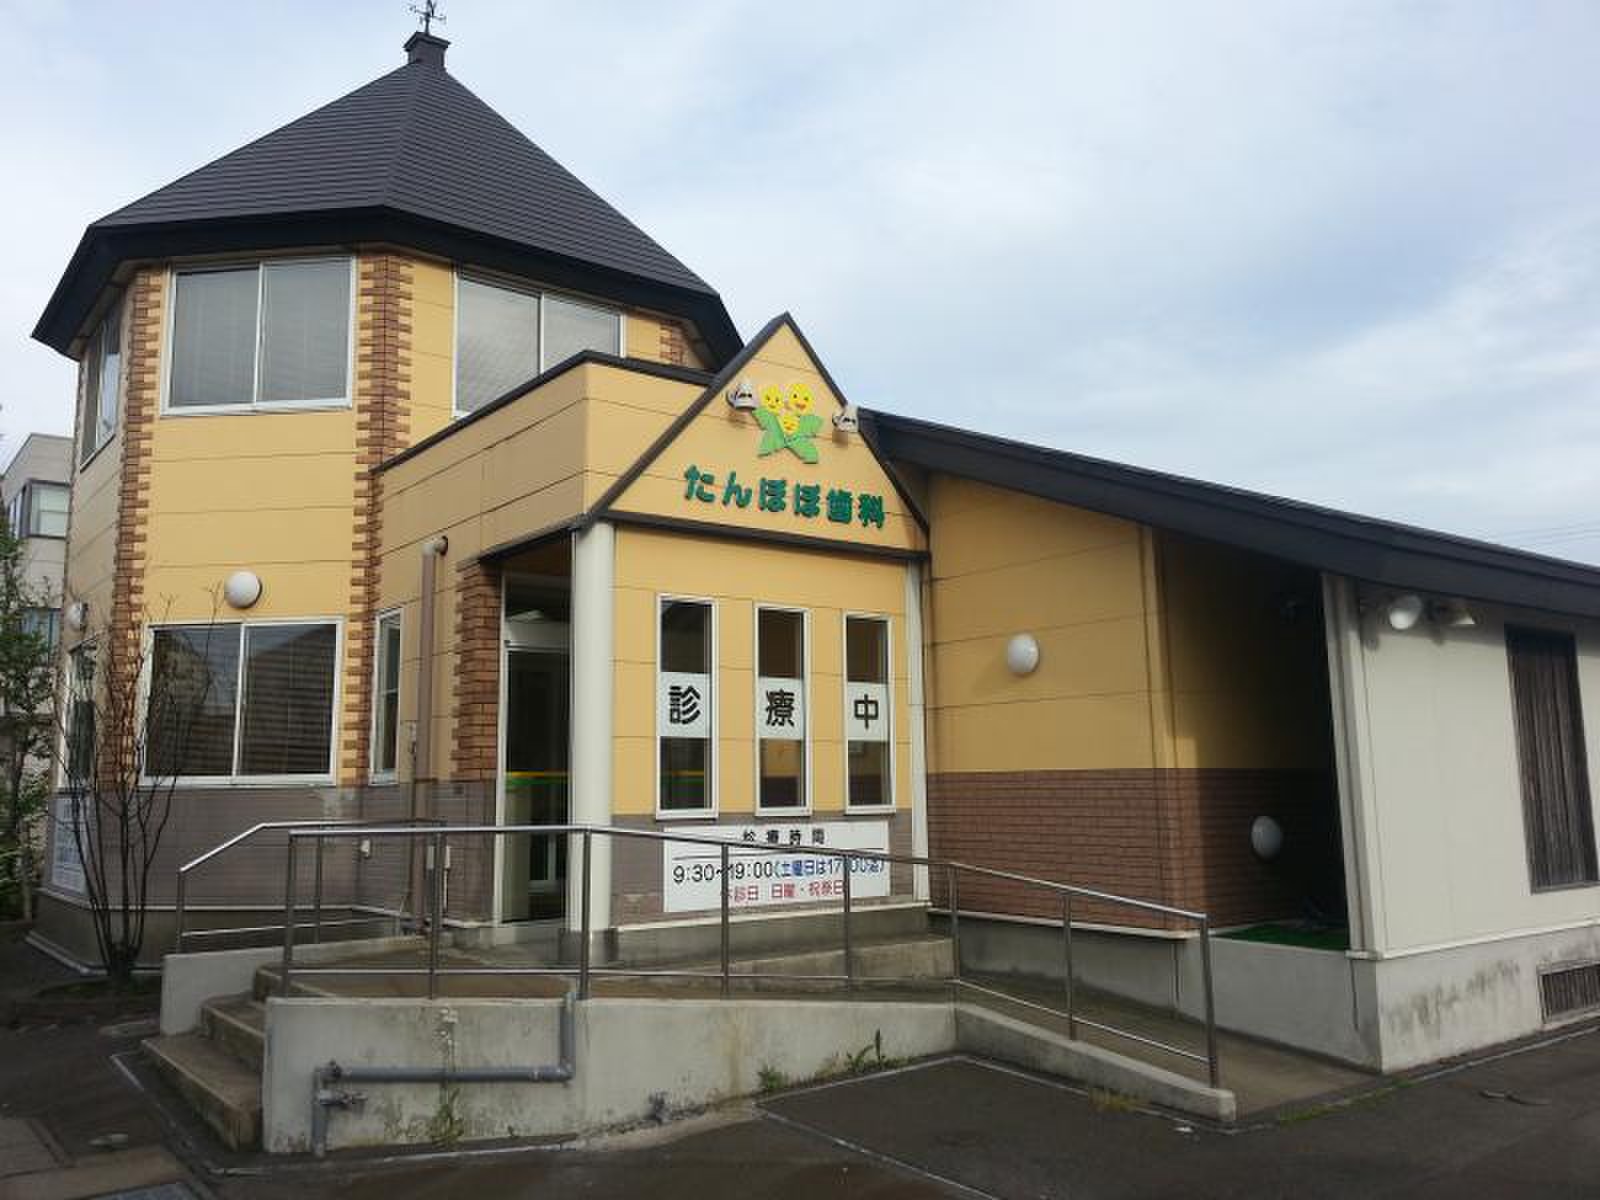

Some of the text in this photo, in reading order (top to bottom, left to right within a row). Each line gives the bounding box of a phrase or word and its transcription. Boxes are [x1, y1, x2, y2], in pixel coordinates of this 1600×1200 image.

[684, 464, 885, 529] たんぽぽ歯科
[669, 685, 879, 730] 診 療 中
